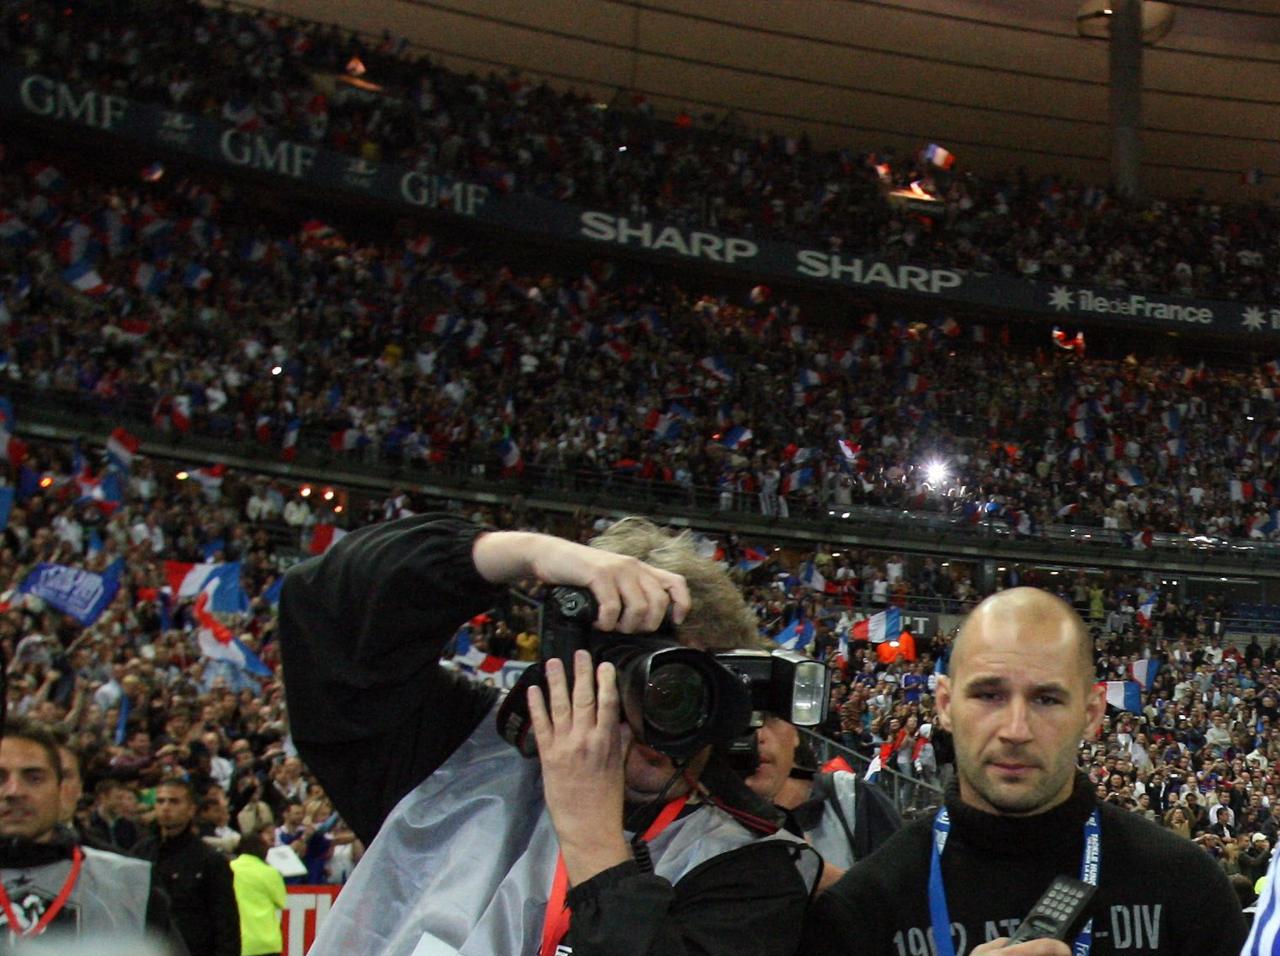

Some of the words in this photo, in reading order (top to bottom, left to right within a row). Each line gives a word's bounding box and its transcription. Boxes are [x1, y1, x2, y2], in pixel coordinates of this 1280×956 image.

[20, 75, 129, 130] GMF
[221, 129, 317, 178] GMF
[401, 169, 489, 216] GMF
[580, 211, 758, 264] SHARP
[797, 249, 963, 294] SHARP
